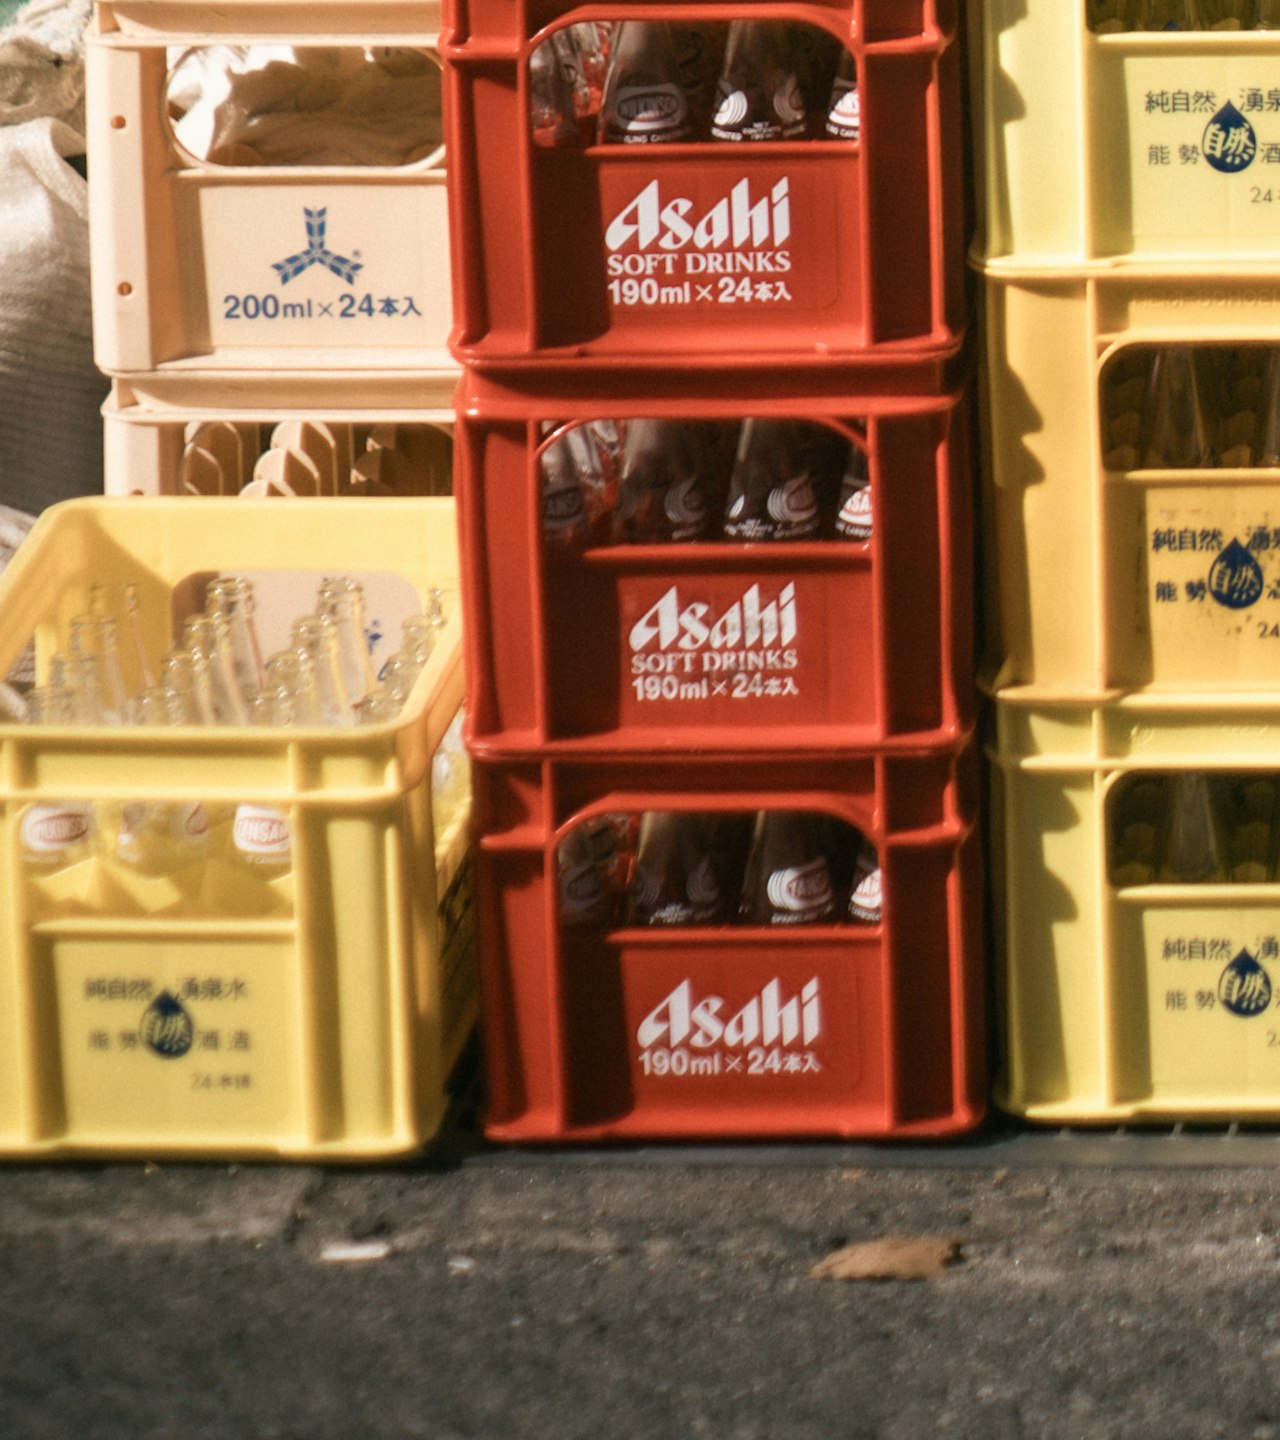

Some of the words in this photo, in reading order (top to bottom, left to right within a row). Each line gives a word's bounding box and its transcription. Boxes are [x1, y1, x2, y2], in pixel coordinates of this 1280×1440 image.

[1145, 89, 1216, 114] 純自然
[604, 176, 790, 251] Asahi
[607, 253, 679, 276] SOFT
[685, 251, 791, 275] DRINKS
[1153, 527, 1223, 552] 純自然
[628, 580, 797, 652] Asahi
[631, 652, 696, 674] SOFT
[702, 649, 798, 671] DRINKS
[1162, 937, 1231, 962] 純自然
[636, 976, 821, 1049] Asahi
